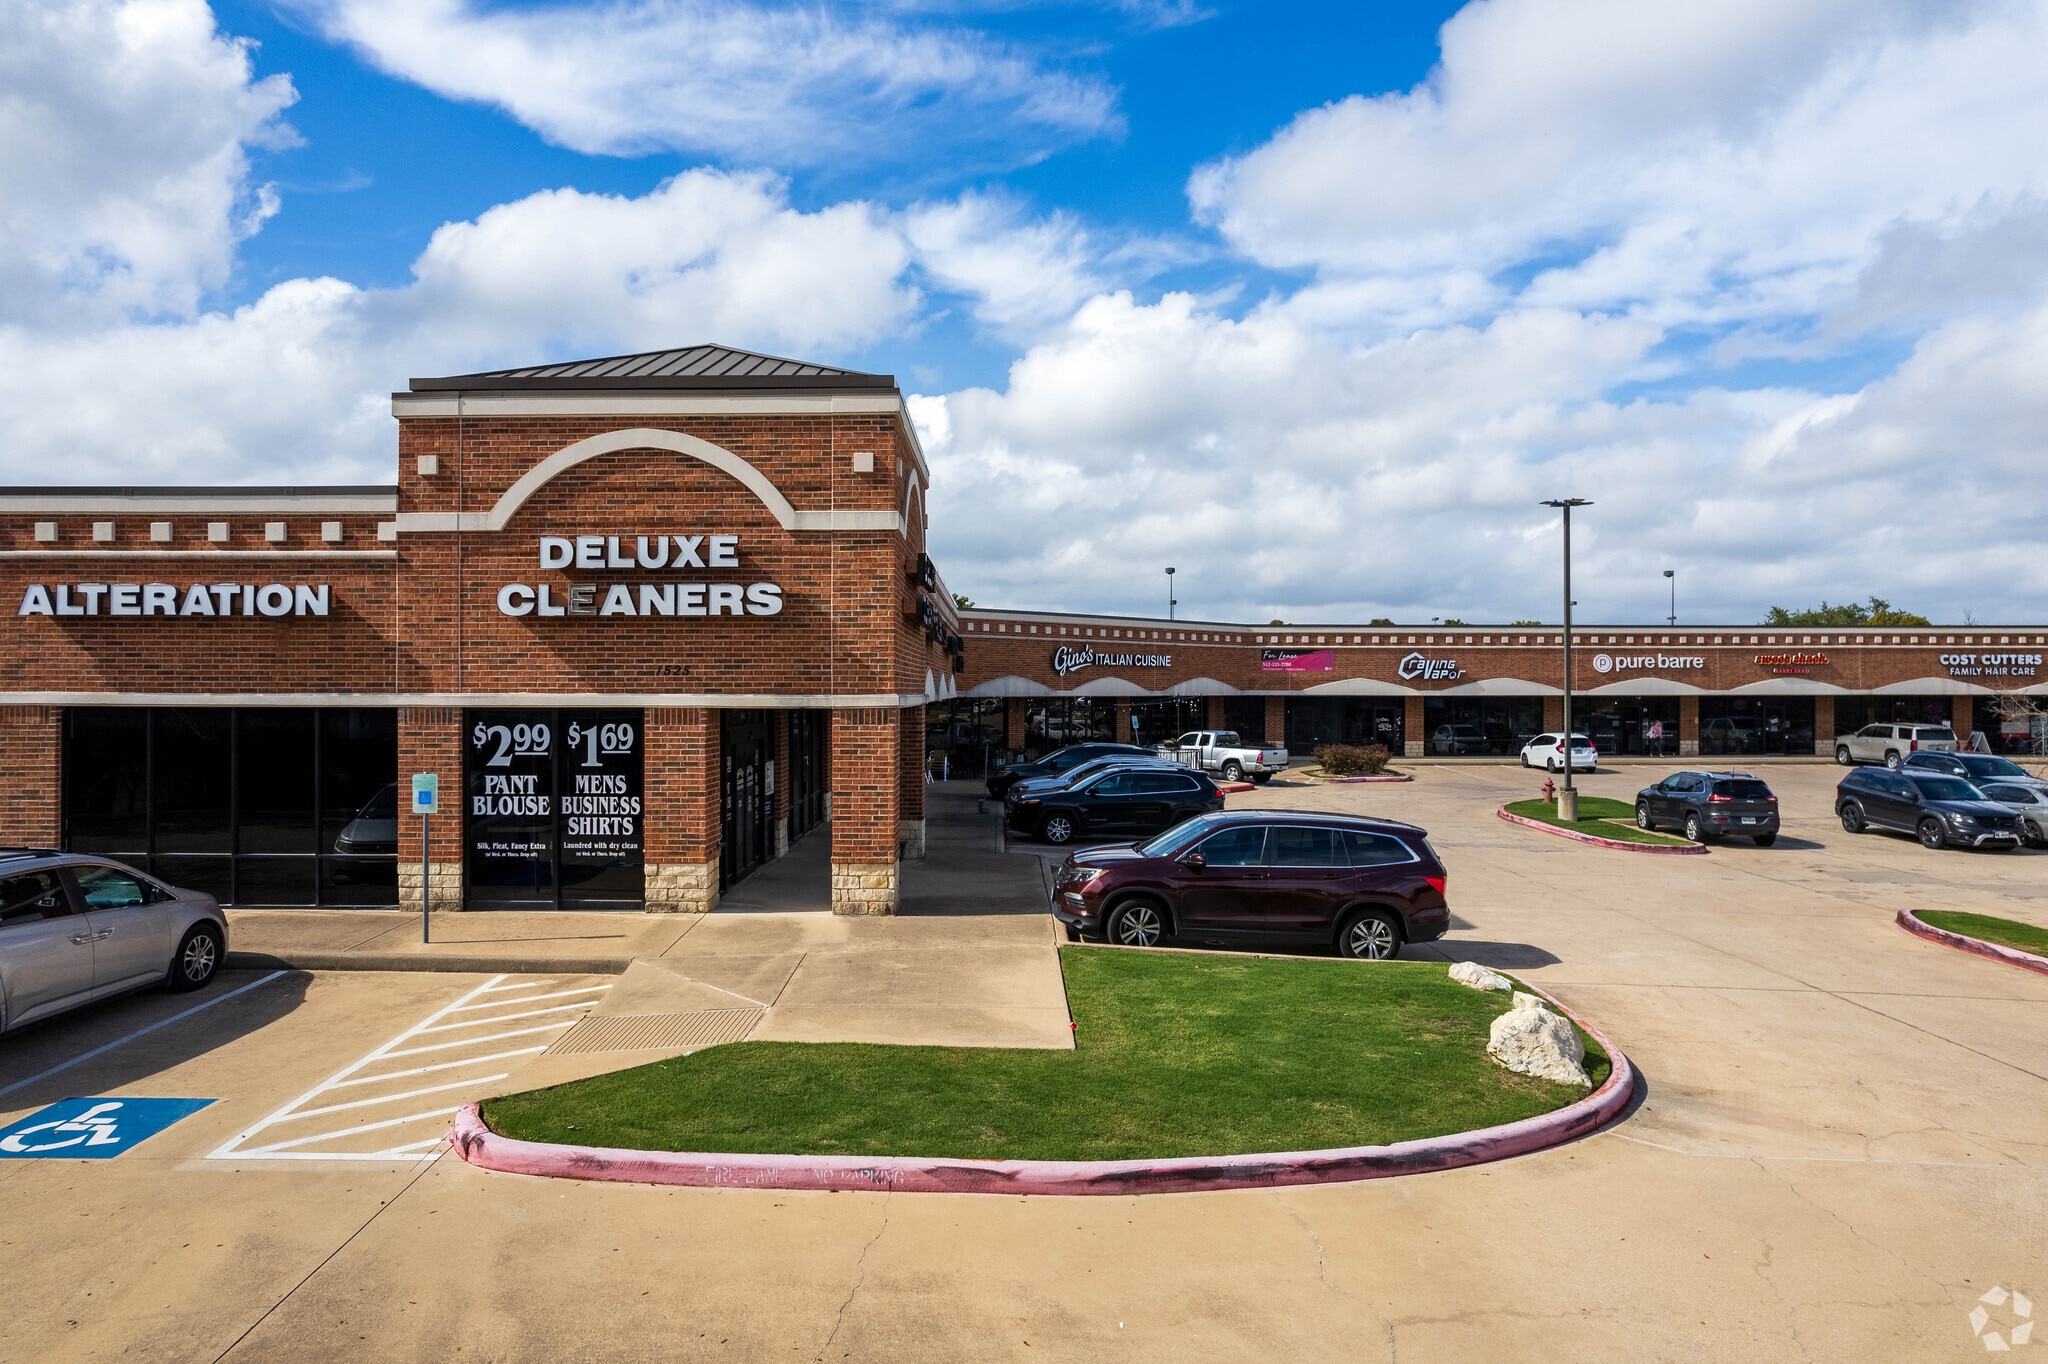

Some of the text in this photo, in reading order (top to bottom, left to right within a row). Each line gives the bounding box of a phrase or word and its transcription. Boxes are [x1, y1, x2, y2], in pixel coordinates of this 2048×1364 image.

[540, 535, 740, 569] DELUXE
[18, 583, 332, 616] ALTERATION
[497, 582, 784, 616] CLEANERS
[1054, 644, 1172, 676] Gino's ITALIAN CUISINE
[1263, 650, 1299, 660] For Lease
[1615, 656, 1655, 672] pure
[1658, 653, 1704, 668] barre
[1939, 654, 2043, 665] COST CUTTERS
[656, 665, 690, 676] 1525
[1950, 667, 2036, 676] FAMILY HAIR CARE
[484, 775, 538, 794] PANT
[575, 774, 627, 794] MENS
[472, 796, 550, 816] BLOUSE
[561, 796, 641, 815] BUSINESS
[567, 817, 634, 836] SHIRTS
[477, 842, 490, 850] Silk,
[511, 842, 528, 851] Fancy
[609, 842, 620, 850] dry
[705, 1165, 738, 1183] FIRE
[813, 1168, 833, 1184] NO
